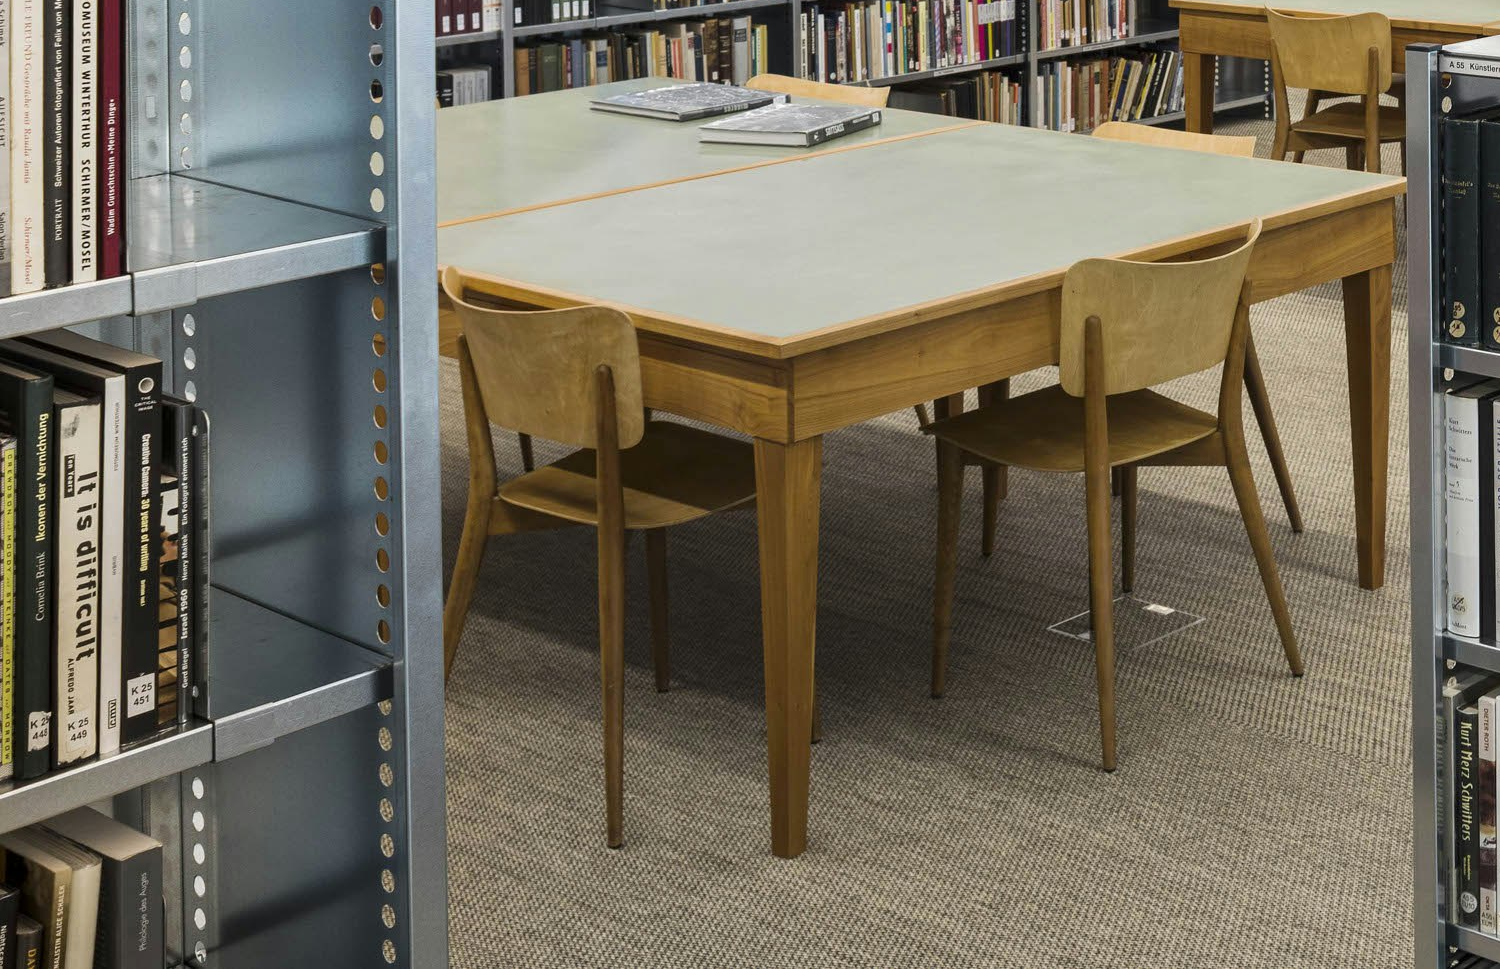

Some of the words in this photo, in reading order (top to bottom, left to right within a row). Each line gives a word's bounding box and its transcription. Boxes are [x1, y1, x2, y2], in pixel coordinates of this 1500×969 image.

[54, 28, 62, 47] Felix
[54, 67, 63, 111] fotografiert
[80, 70, 91, 149] WINTERTHUR
[54, 113, 62, 144] Autoren
[54, 146, 62, 187] Schweizer
[81, 159, 91, 271] SCHIRMER/MOSEL
[36, 414, 49, 480] Vernichtung
[37, 483, 47, 499] der
[77, 471, 97, 494] It
[36, 502, 47, 541] Ikonen
[76, 503, 97, 531] is
[35, 552, 46, 578] Brink
[35, 581, 46, 621] Cornelia
[76, 541, 97, 661] difficult
[134, 695, 150, 705] 451
[68, 723, 75, 731] K
[78, 719, 88, 727] 25
[71, 730, 87, 741] 449
[1460, 721, 1473, 747] Kurt
[1460, 750, 1473, 778] Merz
[1460, 781, 1474, 841] Schwitters
